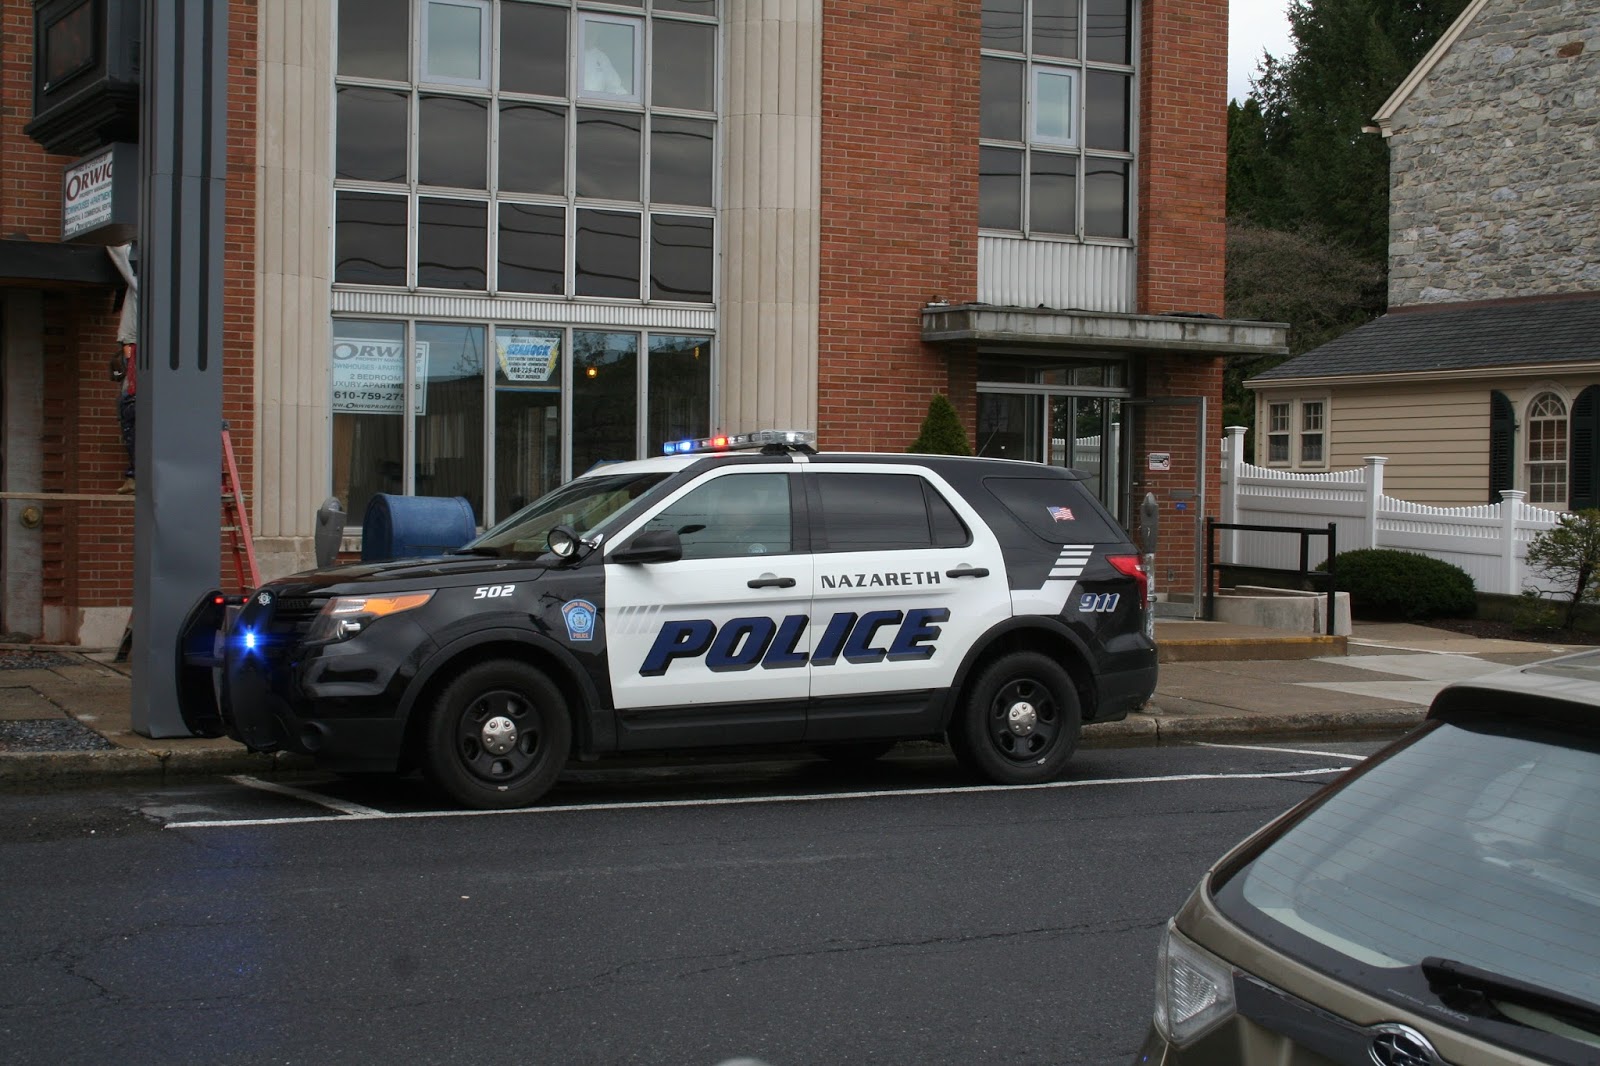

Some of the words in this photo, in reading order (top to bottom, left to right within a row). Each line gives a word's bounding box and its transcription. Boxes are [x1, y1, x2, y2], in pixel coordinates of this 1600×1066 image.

[357, 373, 401, 381] BEDROOM
[820, 571, 941, 589] NAZARETH
[473, 584, 516, 600] 502
[1078, 592, 1121, 613] 911
[638, 607, 951, 677] POLICE
[1427, 1004, 1469, 1022] AWD
